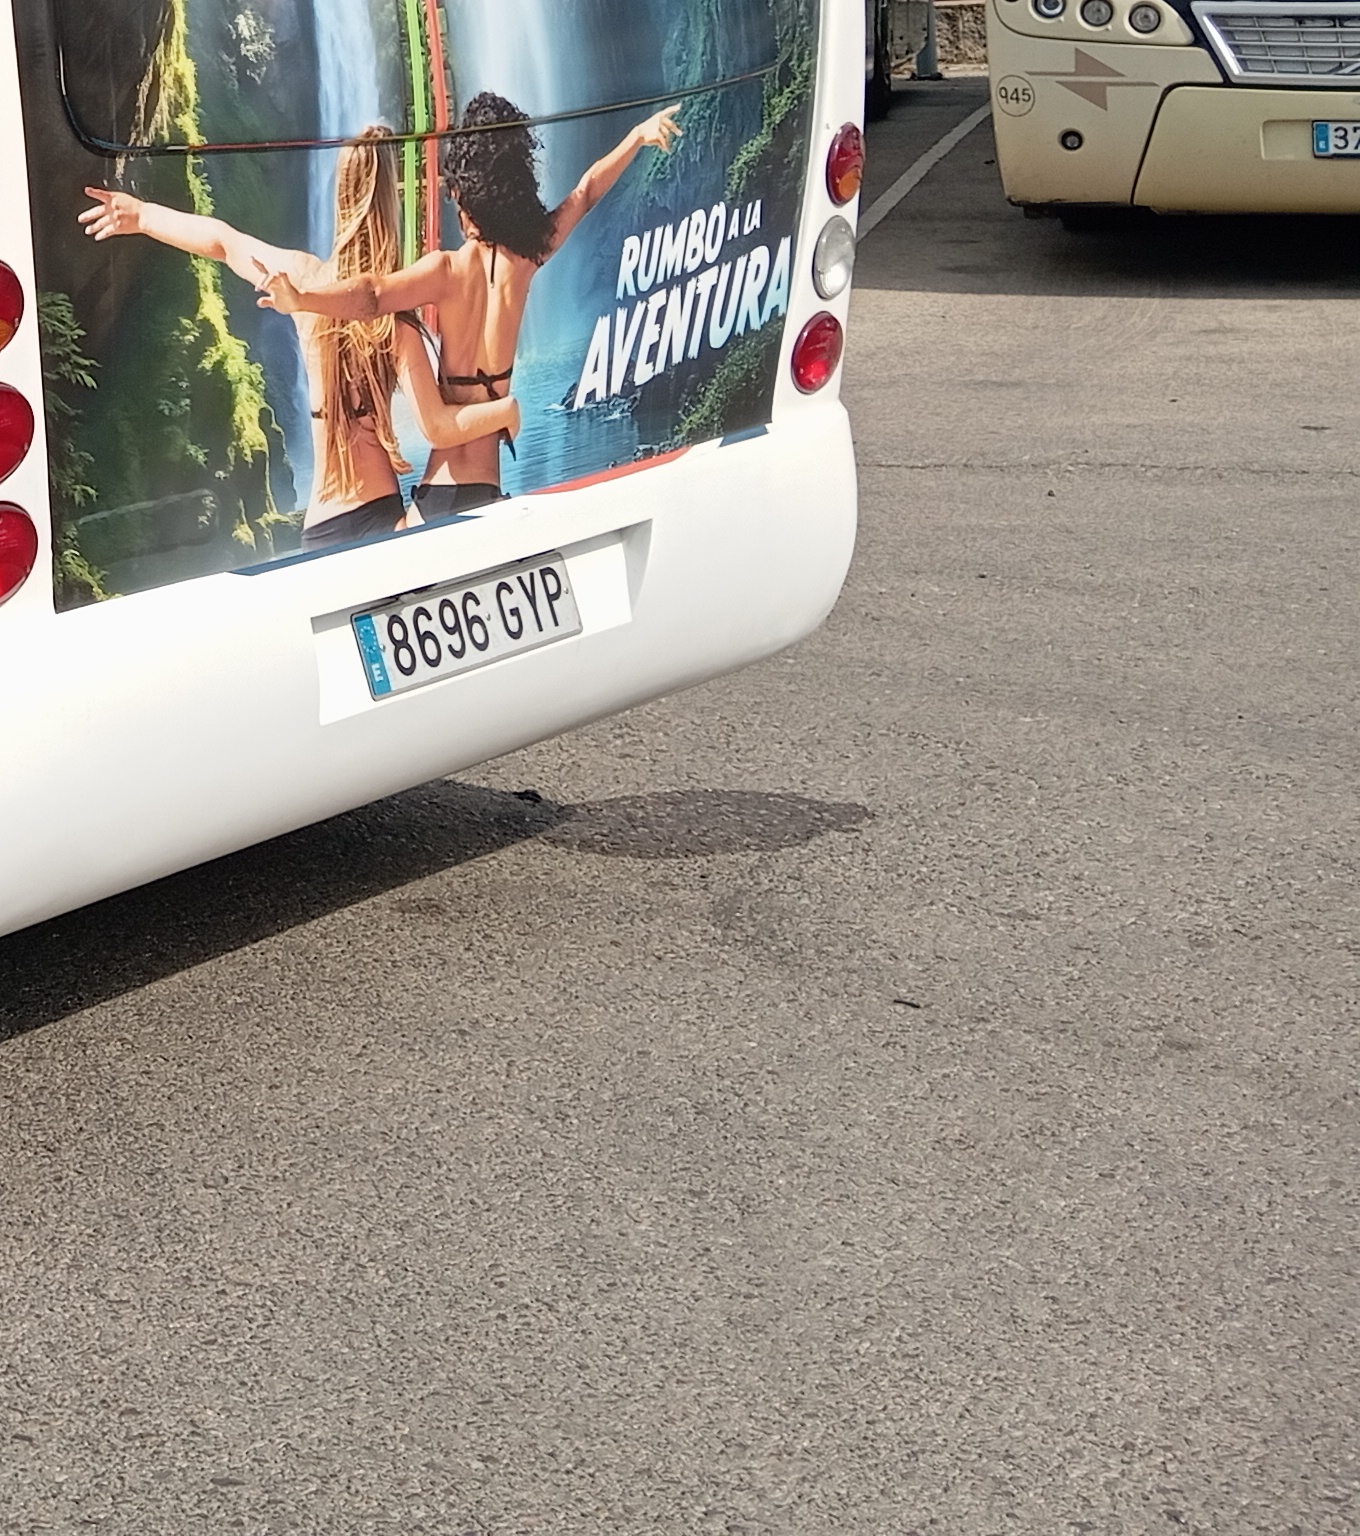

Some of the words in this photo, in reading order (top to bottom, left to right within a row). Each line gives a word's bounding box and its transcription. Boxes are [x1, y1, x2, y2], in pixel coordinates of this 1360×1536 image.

[998, 86, 1032, 105] 945
[615, 201, 727, 301] RUMBO
[727, 208, 740, 240] A
[743, 199, 762, 236] LA
[572, 235, 792, 412] AVENTURA
[387, 590, 490, 676] 8696
[495, 566, 562, 640] GYP
[371, 664, 384, 682] E
